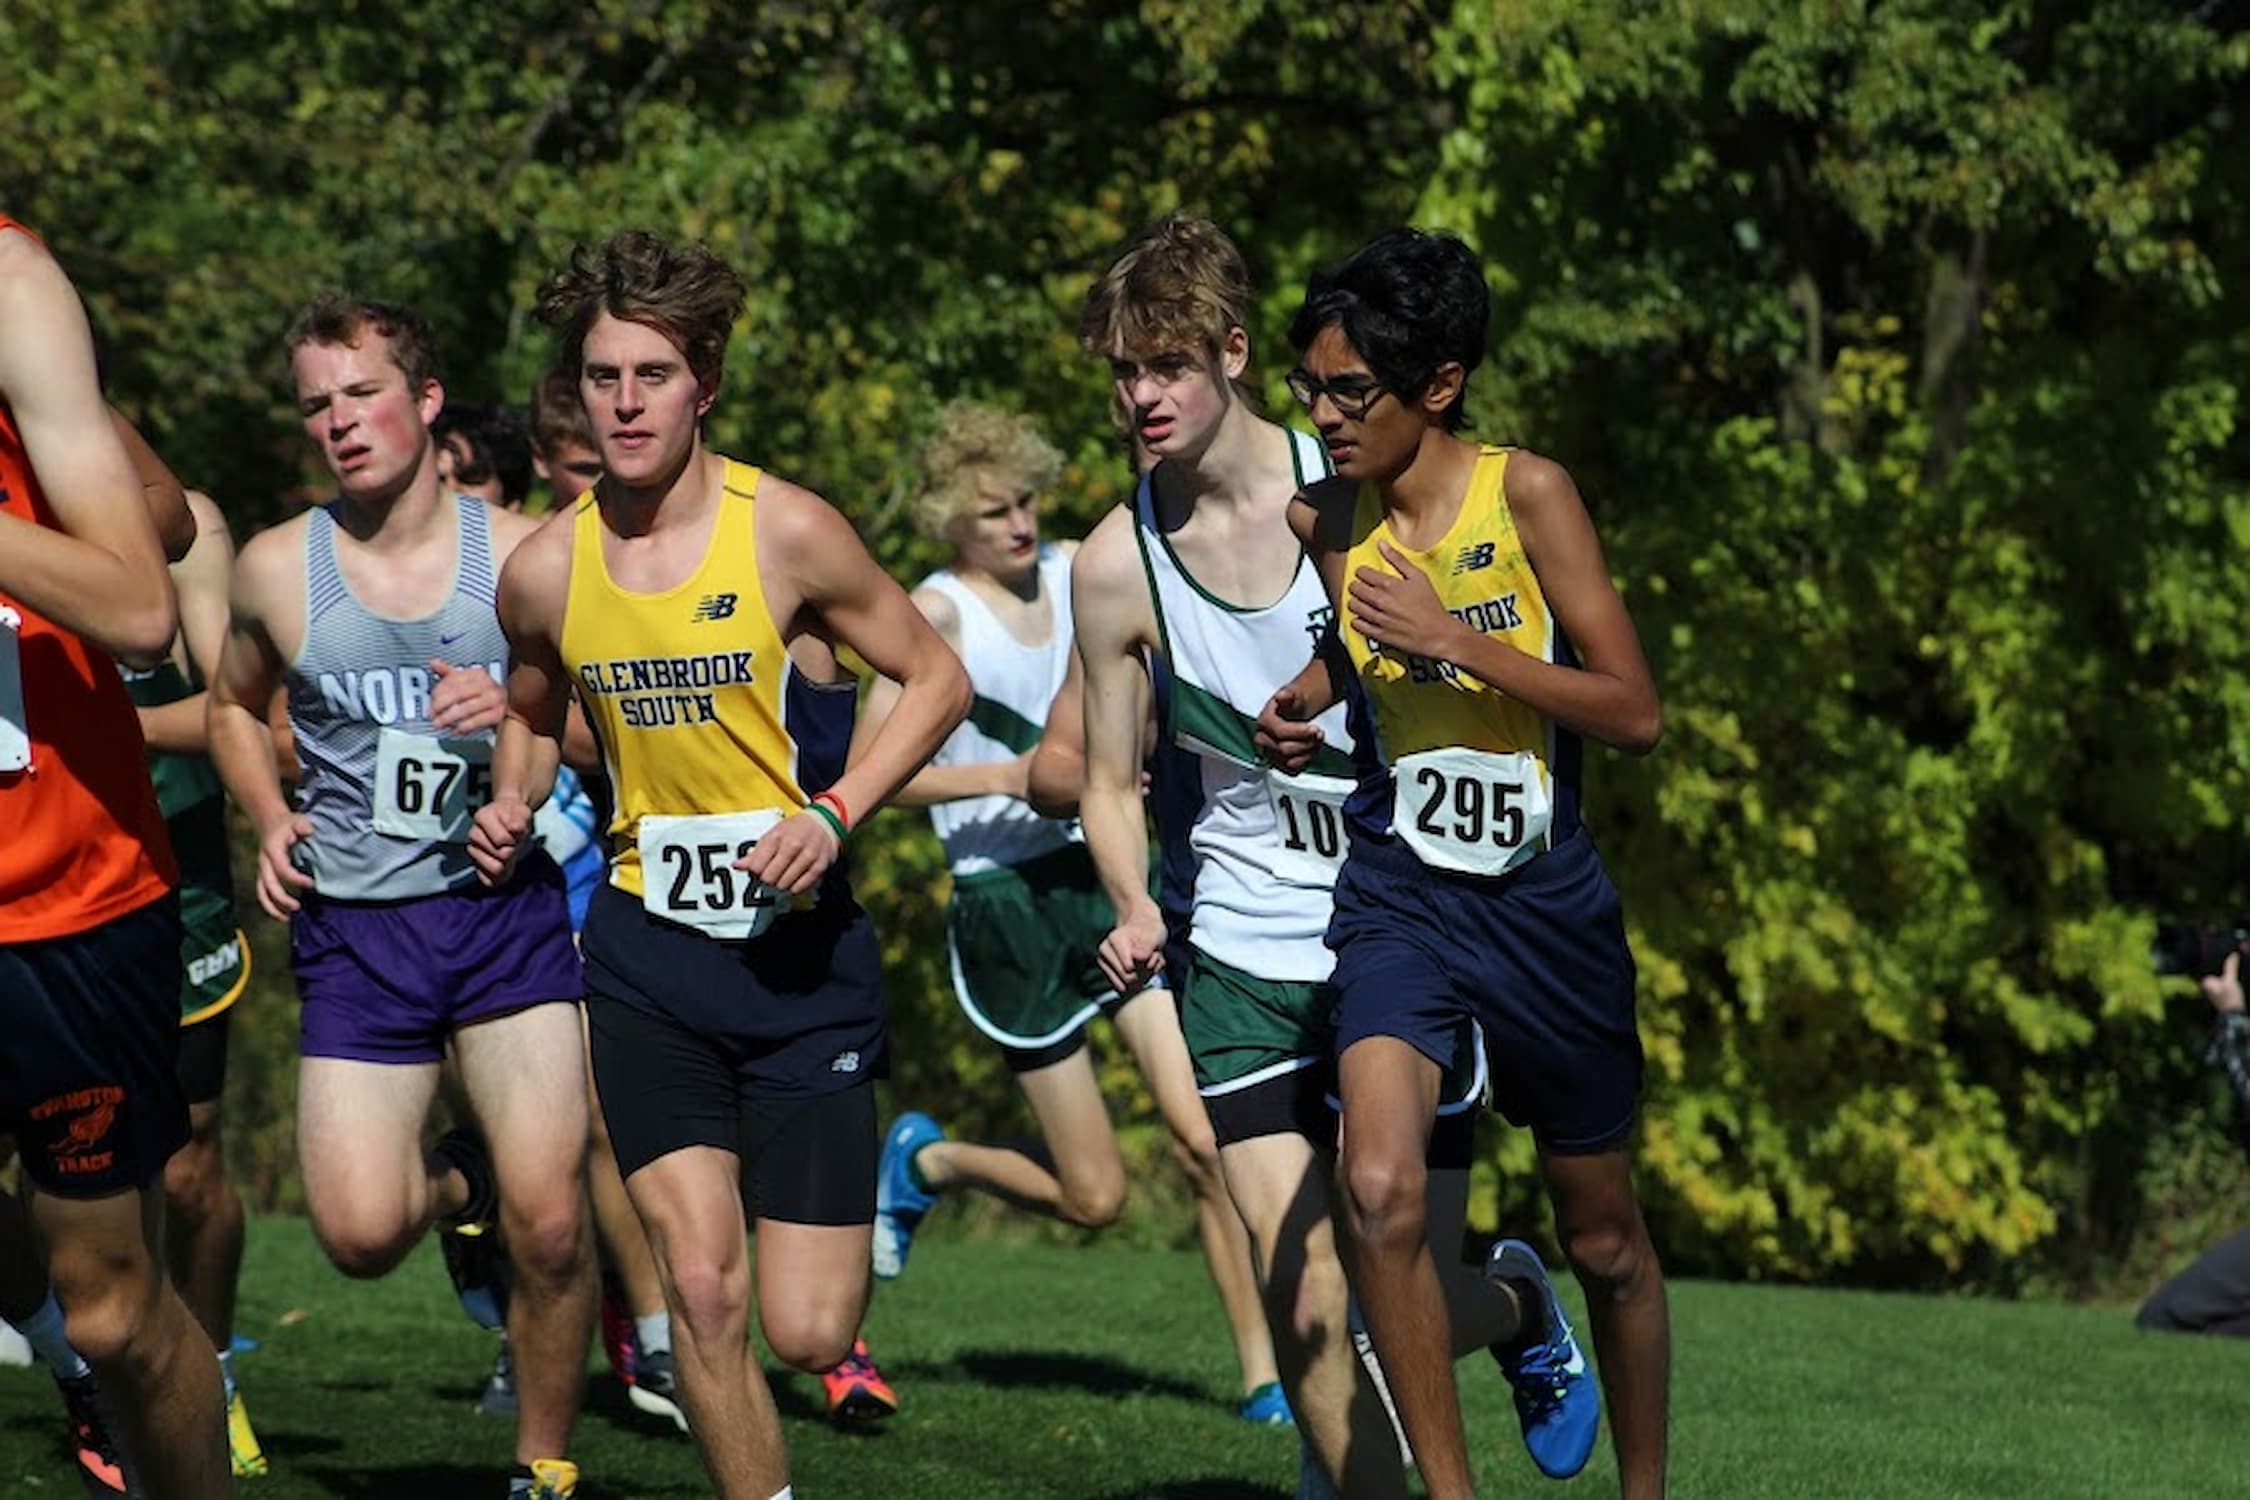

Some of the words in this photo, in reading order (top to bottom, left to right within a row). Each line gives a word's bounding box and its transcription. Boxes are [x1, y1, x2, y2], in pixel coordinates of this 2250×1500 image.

[319, 661, 501, 725] NOR
[581, 652, 753, 693] GLENBROOK
[620, 694, 715, 727] SOUTH
[1278, 794, 1350, 858] 10
[1416, 767, 1525, 848] 295
